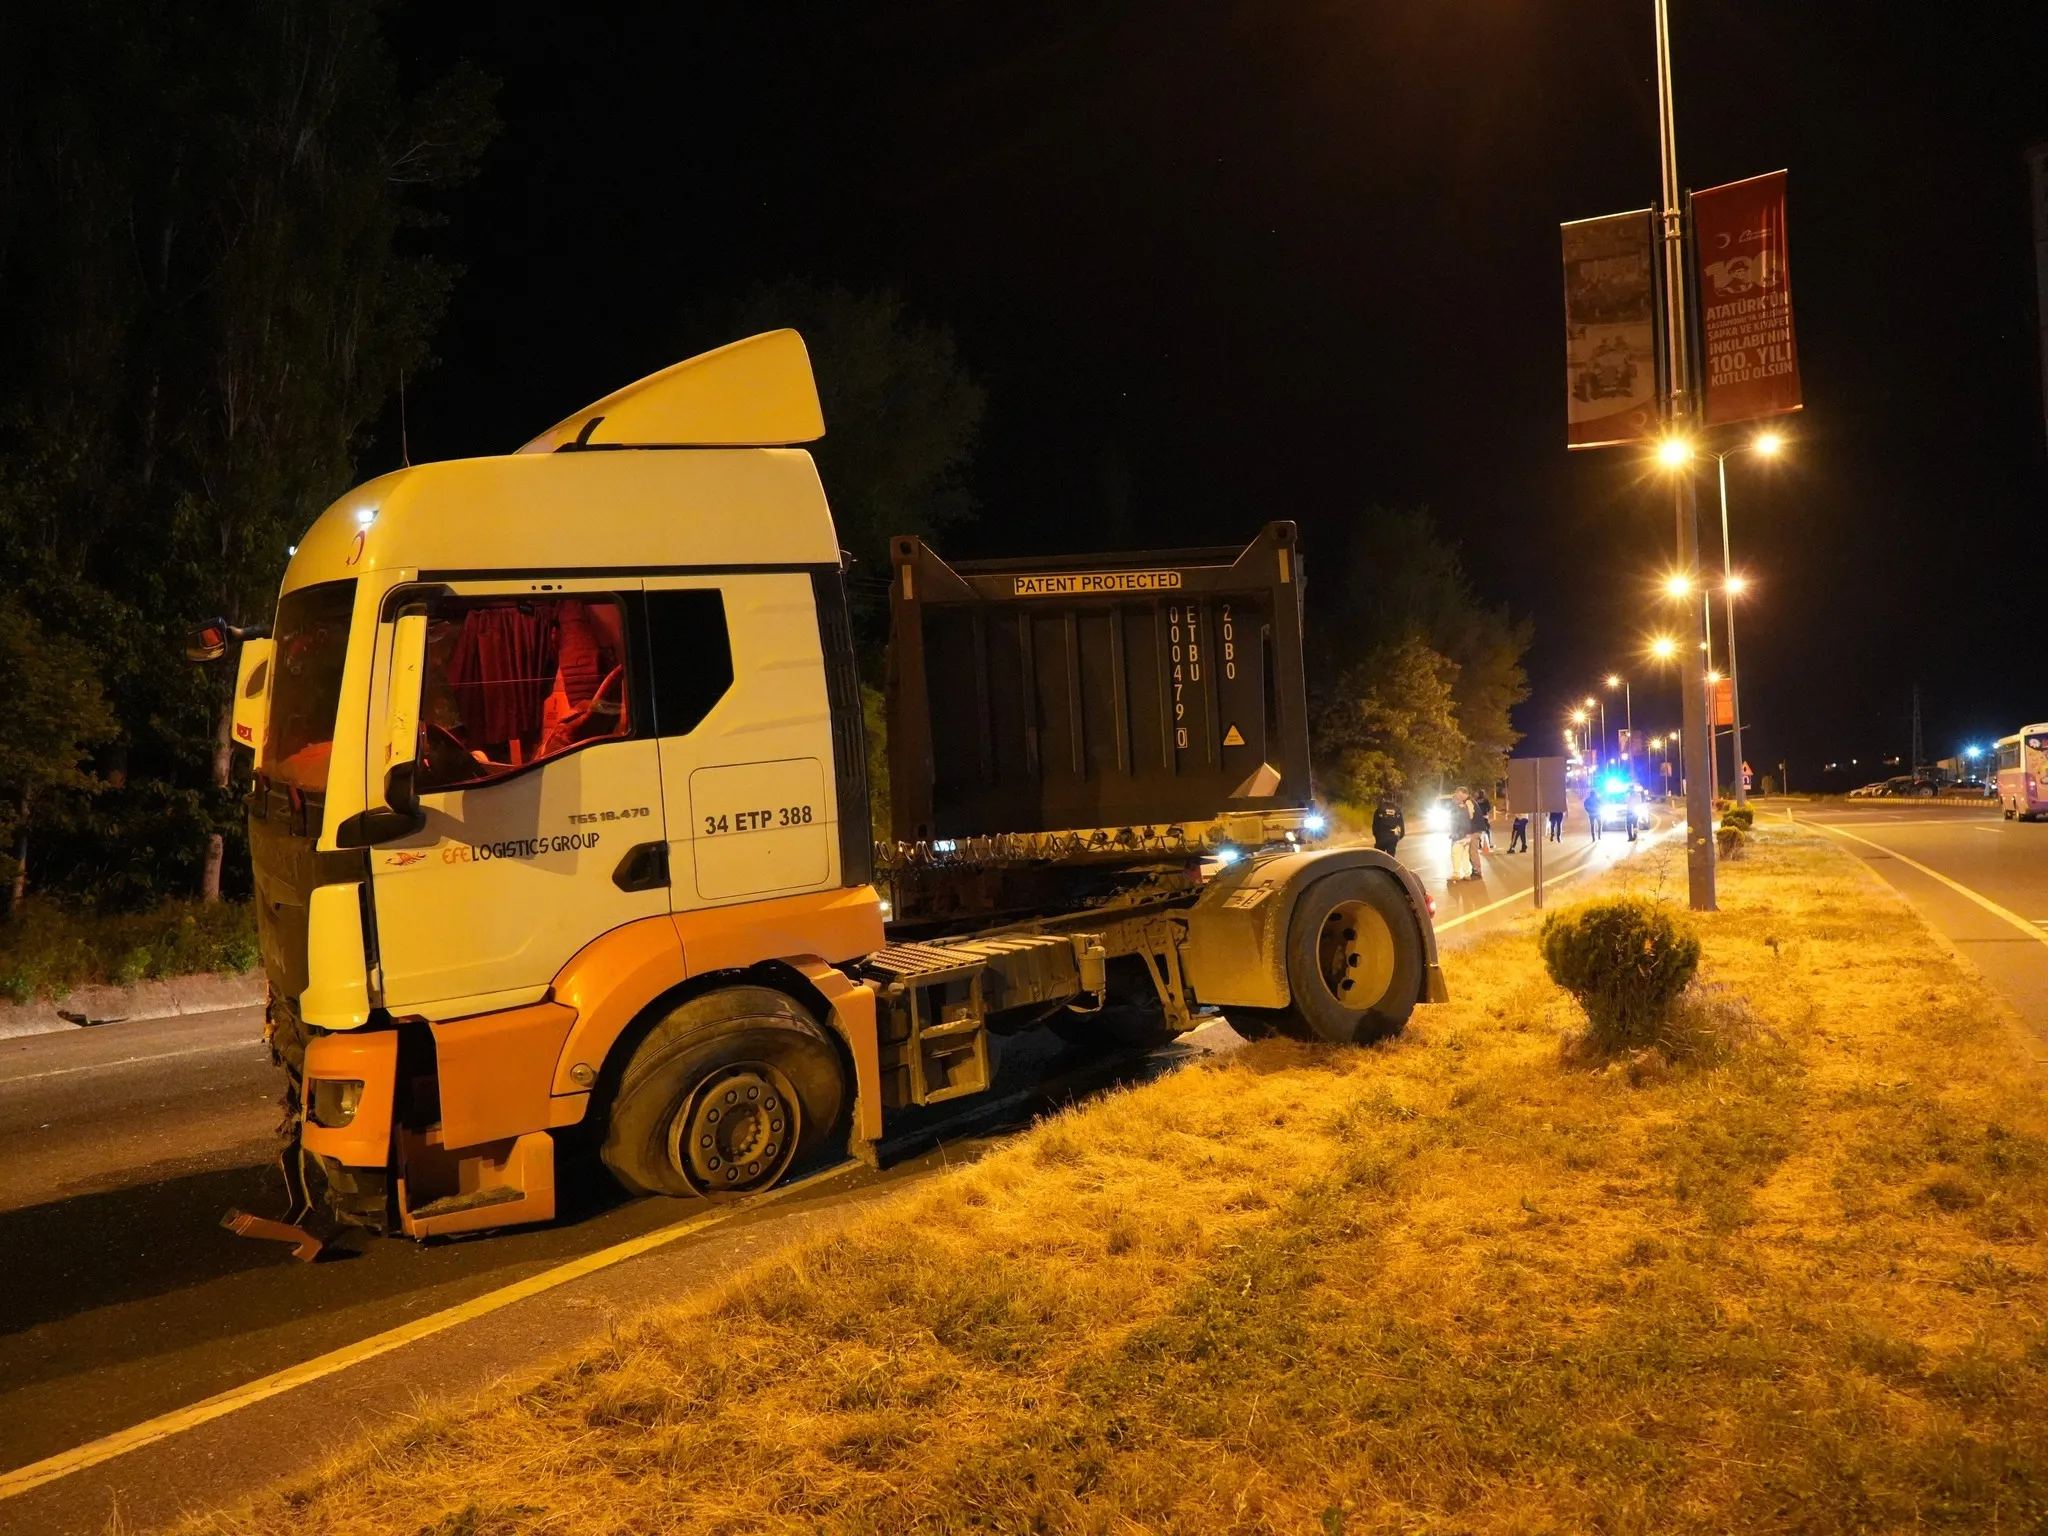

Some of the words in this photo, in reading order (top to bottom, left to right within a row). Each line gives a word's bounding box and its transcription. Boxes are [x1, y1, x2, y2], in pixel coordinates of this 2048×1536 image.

[1707, 291, 1789, 320] ATATÜRK'ÜN
[1708, 326, 1739, 341] ŞAPKA
[1740, 324, 1752, 335] VE
[1710, 352, 1753, 373] 100.
[1757, 342, 1792, 365] YILI
[1711, 369, 1750, 386] KUTLU
[1753, 362, 1793, 379] OLSUN
[1016, 576, 1077, 594] PATENT
[1081, 572, 1179, 592] PROTECTED
[1186, 606, 1200, 682] ETBU
[600, 807, 650, 822] 18.470
[705, 815, 729, 834] 34
[735, 811, 773, 832] ETP
[779, 806, 813, 826] 388
[550, 832, 599, 851] GROUP
